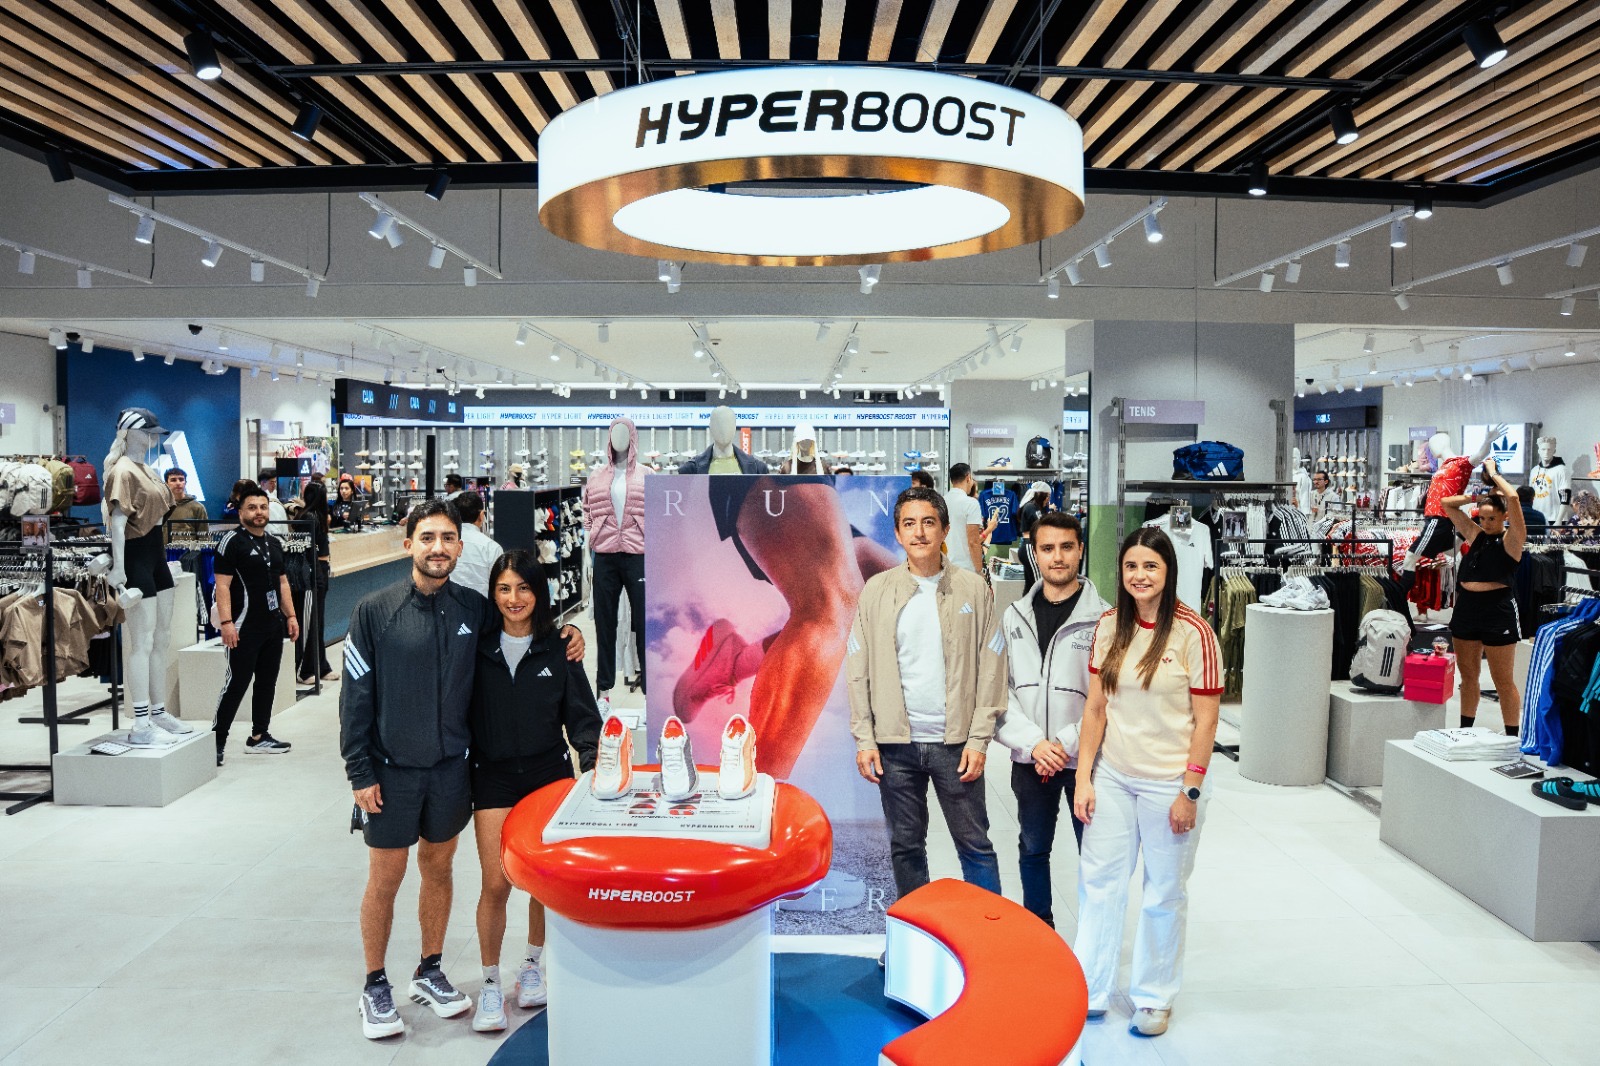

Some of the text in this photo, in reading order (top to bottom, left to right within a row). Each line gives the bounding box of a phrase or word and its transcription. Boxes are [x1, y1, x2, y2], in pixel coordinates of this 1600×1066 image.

[635, 89, 1025, 148] HYPERBOOST
[1129, 405, 1156, 417] TENIS
[1071, 641, 1093, 652] Revo
[588, 888, 695, 903] HYPERBOOST
